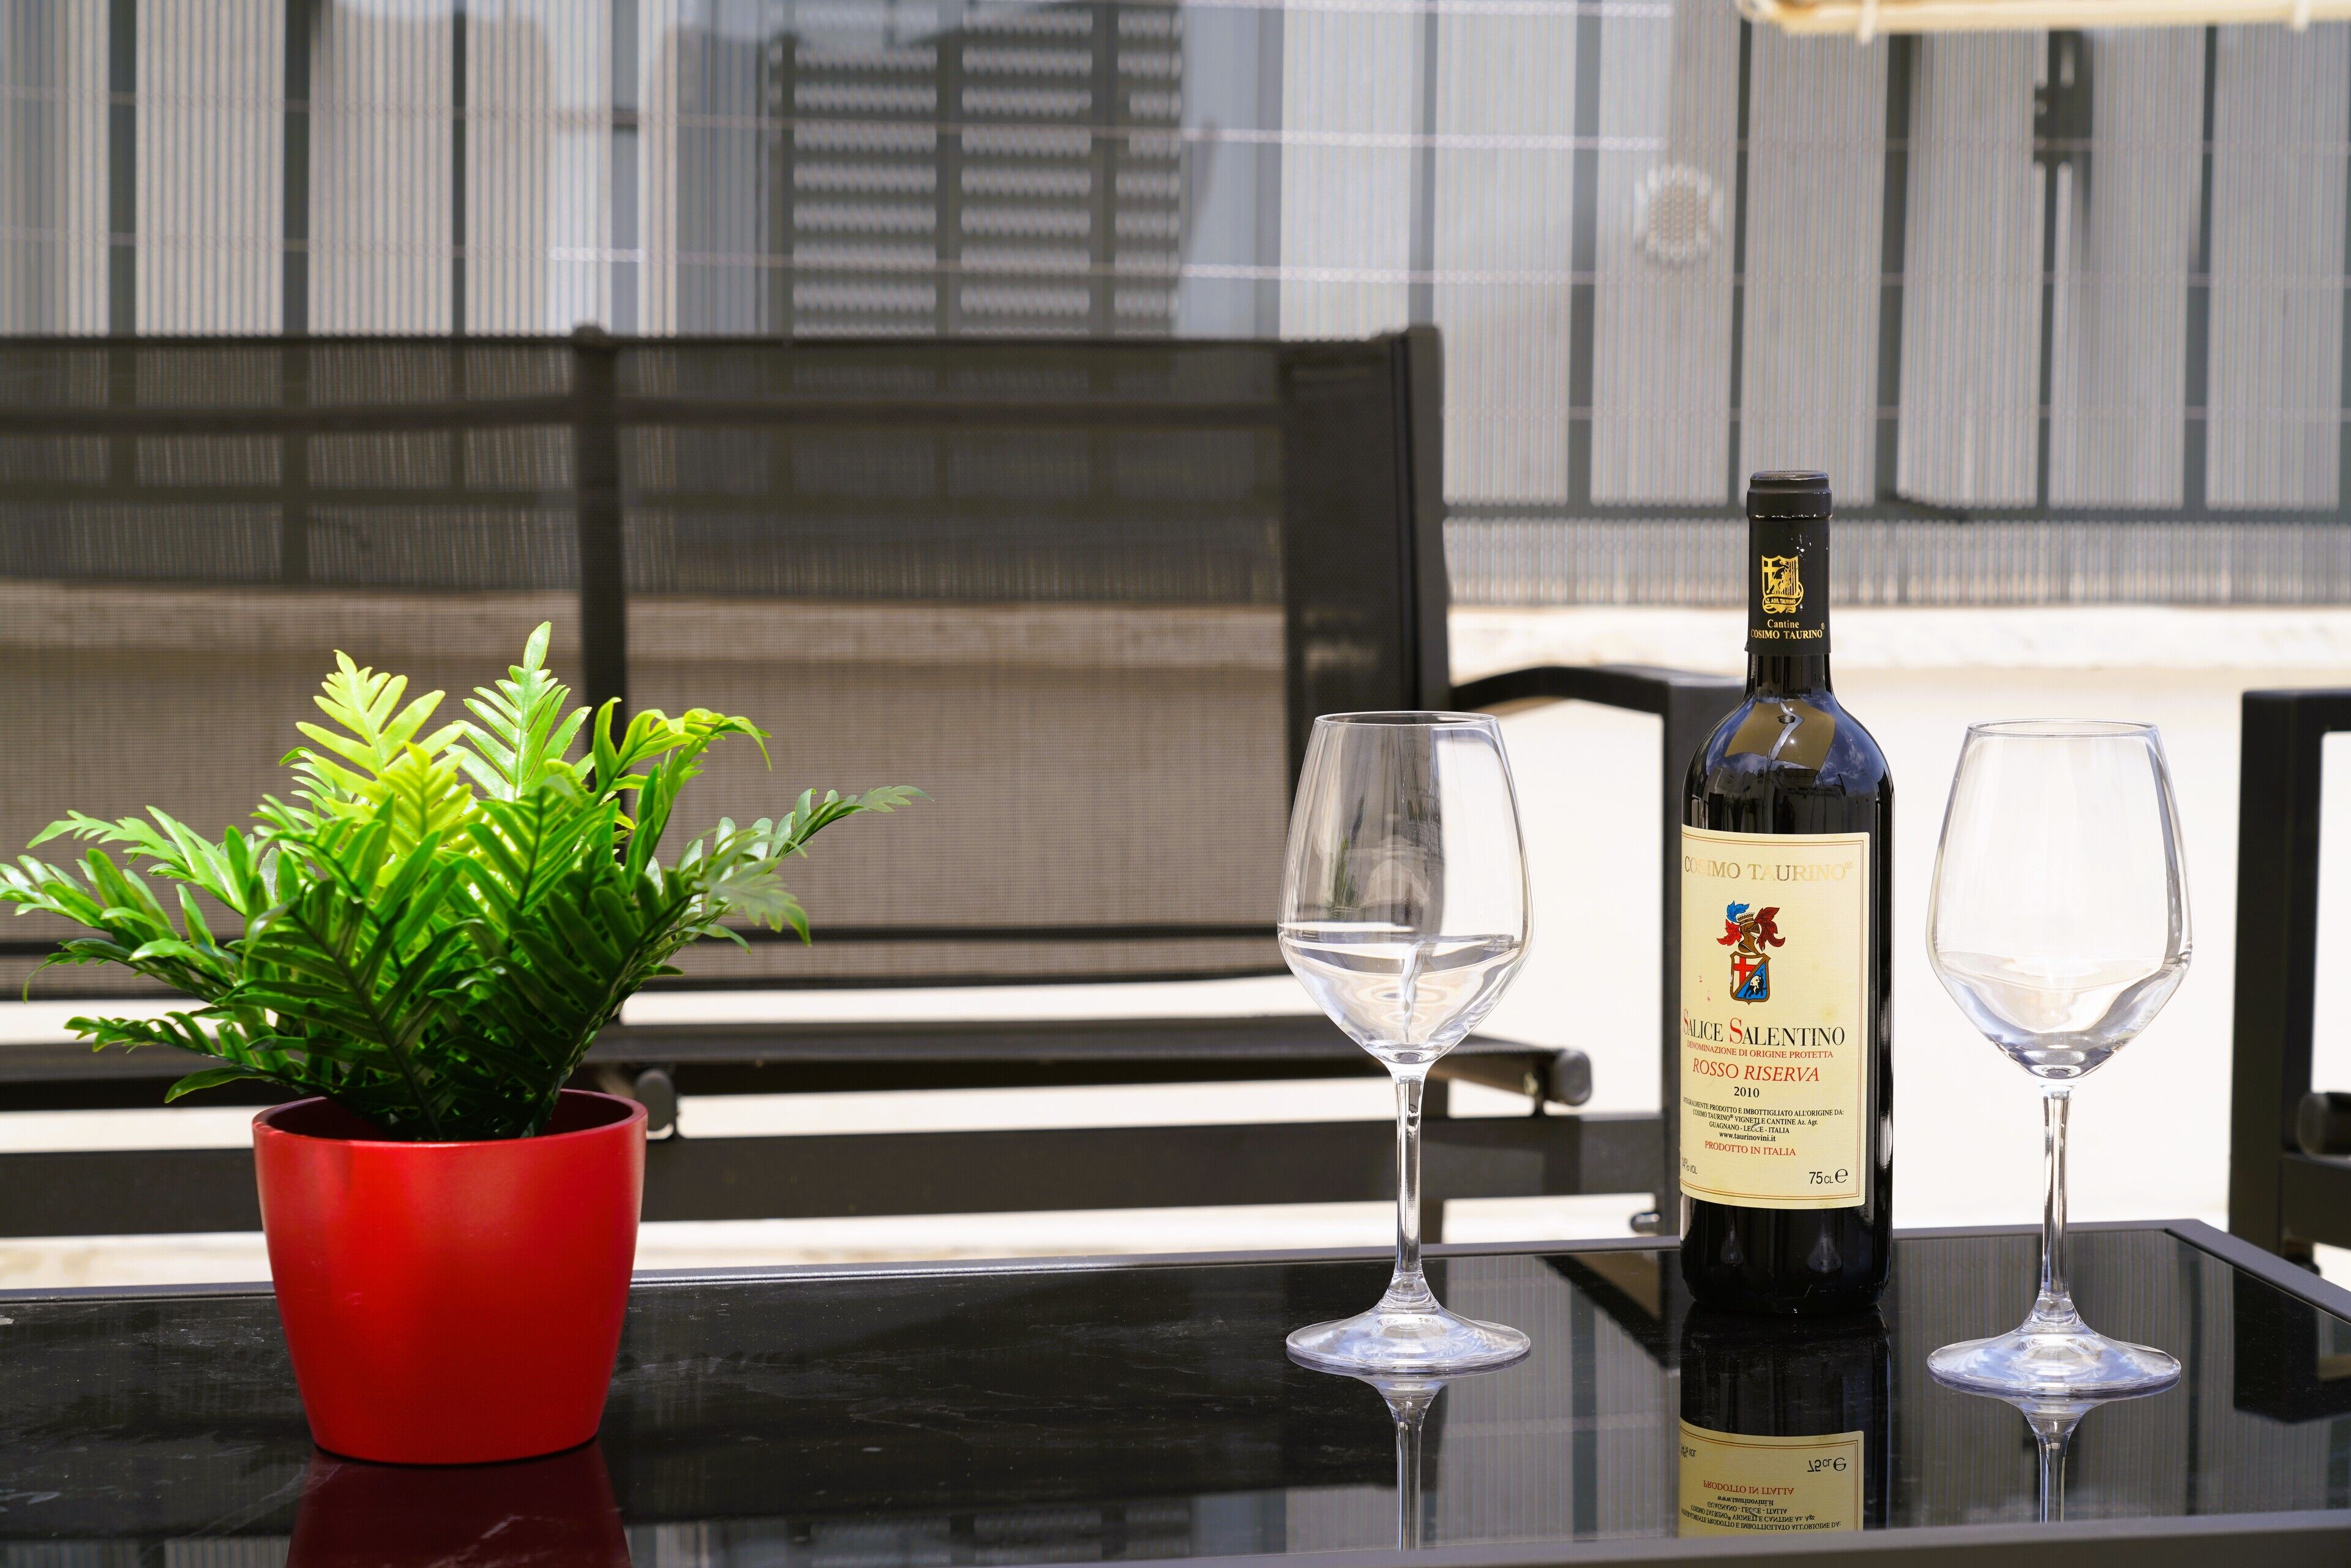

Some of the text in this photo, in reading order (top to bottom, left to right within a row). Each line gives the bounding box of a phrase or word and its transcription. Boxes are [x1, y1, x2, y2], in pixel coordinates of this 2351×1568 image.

[1767, 619, 1799, 628] Cantine
[1751, 629, 1780, 639] COSIMO
[1685, 856, 1741, 879] COSIMO
[1683, 1008, 1845, 1046] SALICE SALENTINO
[1687, 1040, 1737, 1056] DENOMINAZIONE
[1692, 1058, 1820, 1082] ROSSO RISERVA
[1734, 1086, 1760, 1098] 2010
[1692, 1109, 1707, 1118] COSIMO
[1709, 1105, 1738, 1114] PRODOTTO
[1709, 1121, 1739, 1131] GUAGNANO
[1719, 1132, 1775, 1141] www.taurinovini.it
[1704, 1140, 1748, 1153] PRODOTTO
[1763, 1147, 1796, 1156] ITALIA
